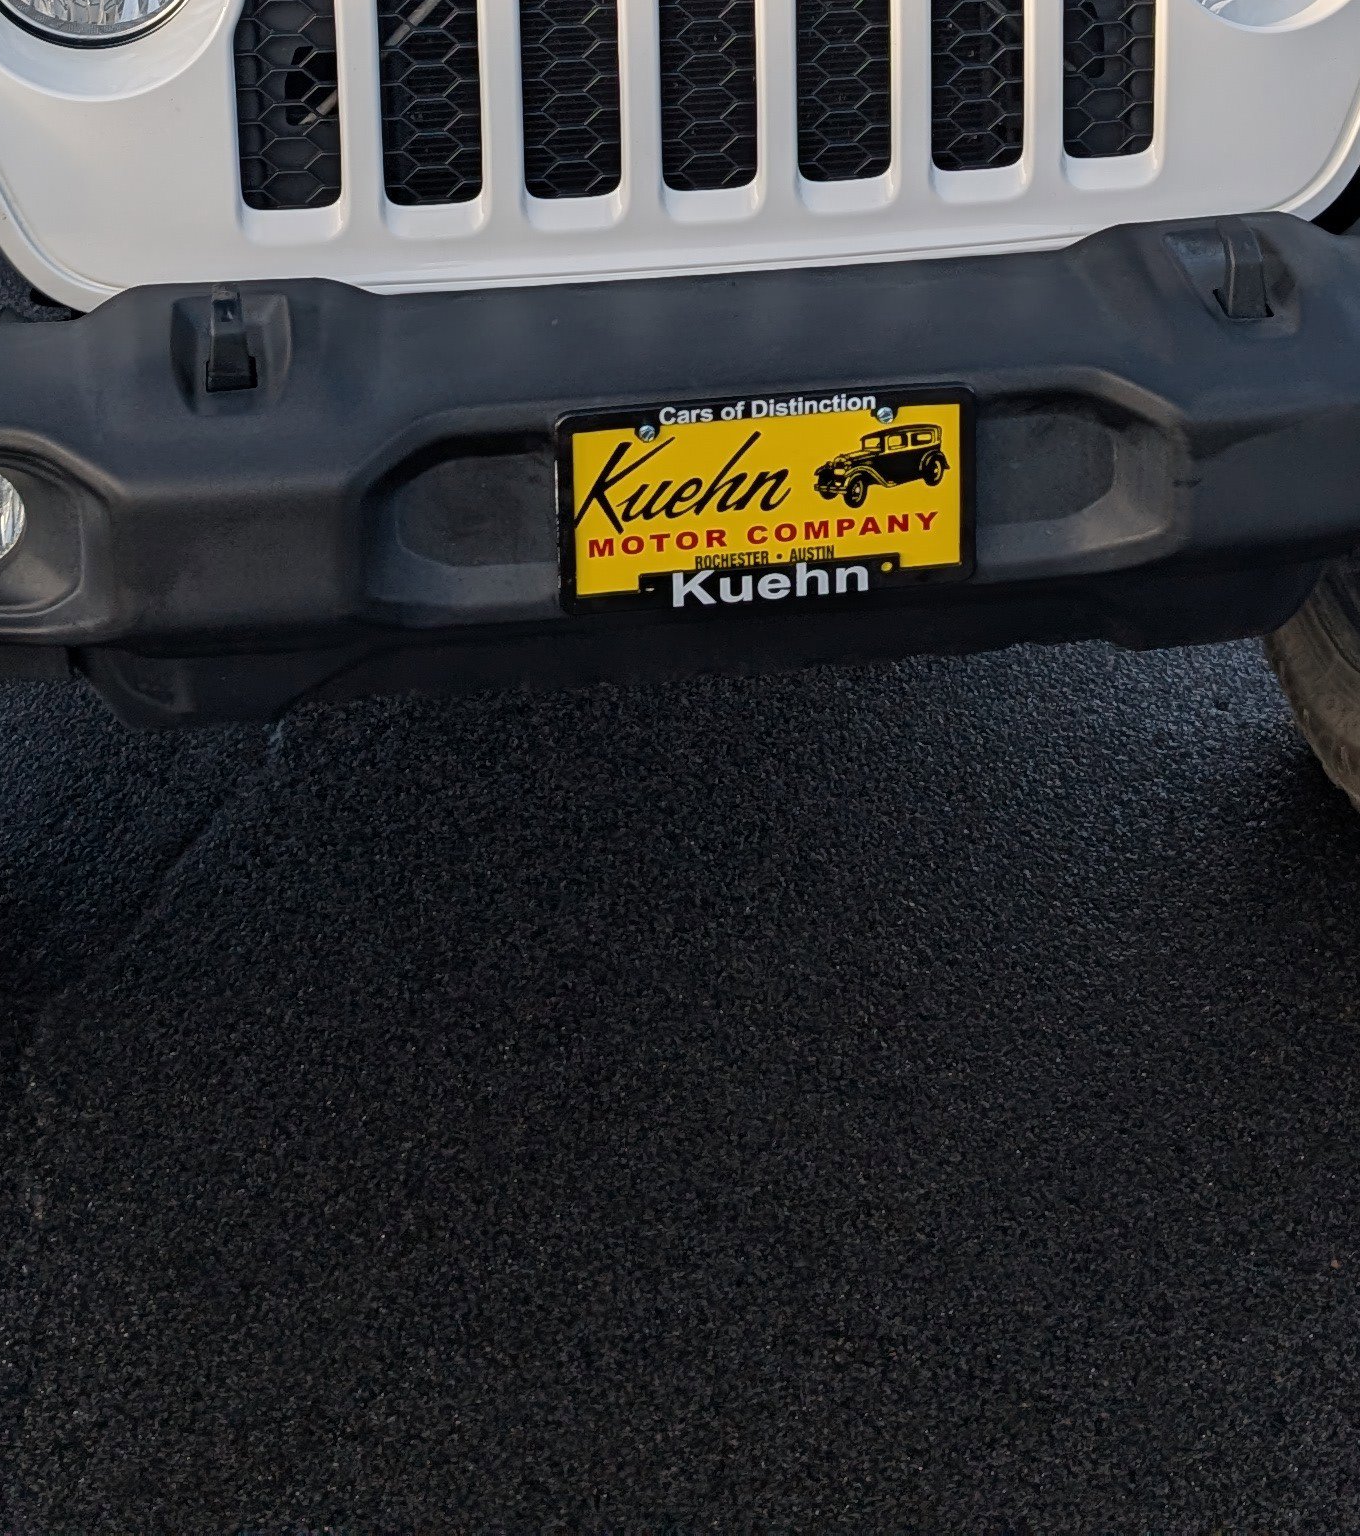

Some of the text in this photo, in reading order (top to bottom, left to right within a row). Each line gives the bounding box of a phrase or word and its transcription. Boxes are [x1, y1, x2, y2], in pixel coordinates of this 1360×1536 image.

[658, 393, 877, 427] Cars of Distinction
[574, 430, 792, 535] Kuehn
[588, 510, 940, 559] MOTOR COMPANY
[694, 544, 835, 570] ROCHESTER AUSTIN
[671, 561, 870, 609] Kuehn
